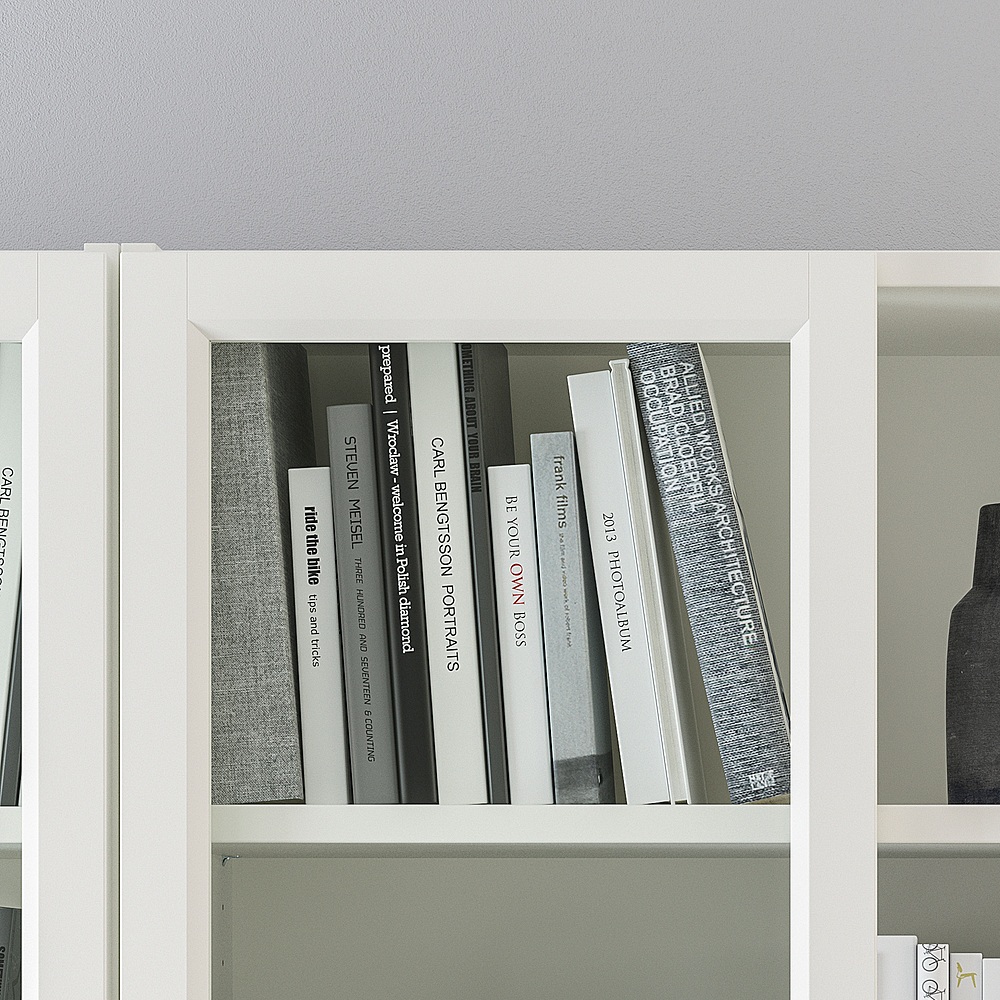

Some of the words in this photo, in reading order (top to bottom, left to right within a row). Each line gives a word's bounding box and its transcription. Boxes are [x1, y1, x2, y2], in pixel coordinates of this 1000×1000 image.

[378, 345, 397, 404] prepared
[660, 366, 685, 416] BRAD
[464, 394, 477, 429] ABOUT
[641, 370, 682, 492] OCCUPATION
[344, 436, 360, 490] STEVEN
[386, 419, 401, 475] Wroclaw
[431, 437, 446, 478] CARL
[468, 429, 479, 462] YOUR
[470, 463, 482, 493] BRAIN
[553, 455, 567, 490] frank
[305, 506, 318, 532] ride
[390, 484, 405, 540] welcome
[505, 496, 518, 512] BE
[556, 495, 569, 529] films
[679, 362, 706, 425] ALLIED
[696, 430, 724, 497] WORKS
[711, 502, 759, 644] ARCHITECTURE
[349, 499, 364, 549] MEISEL
[434, 481, 453, 576] BENGTSSON
[506, 517, 521, 559] YOUR
[602, 512, 617, 542] 2013
[306, 534, 319, 556] the
[396, 544, 409, 557] in
[307, 558, 321, 586] bike
[354, 557, 364, 584] THREE
[396, 557, 410, 595] Polish
[509, 563, 526, 605] OWN
[307, 594, 317, 613] tips
[356, 588, 366, 630] HUNDRED
[608, 551, 632, 652] PHOTOALBUM
[309, 616, 320, 636] and
[359, 633, 367, 653] AND
[399, 597, 415, 653] diamond
[441, 584, 460, 672] PORTRAITS
[513, 612, 527, 648] BOSS
[310, 639, 321, 668] tricks
[361, 656, 371, 704] SEVENTEEN
[365, 717, 375, 762] COUNTING
